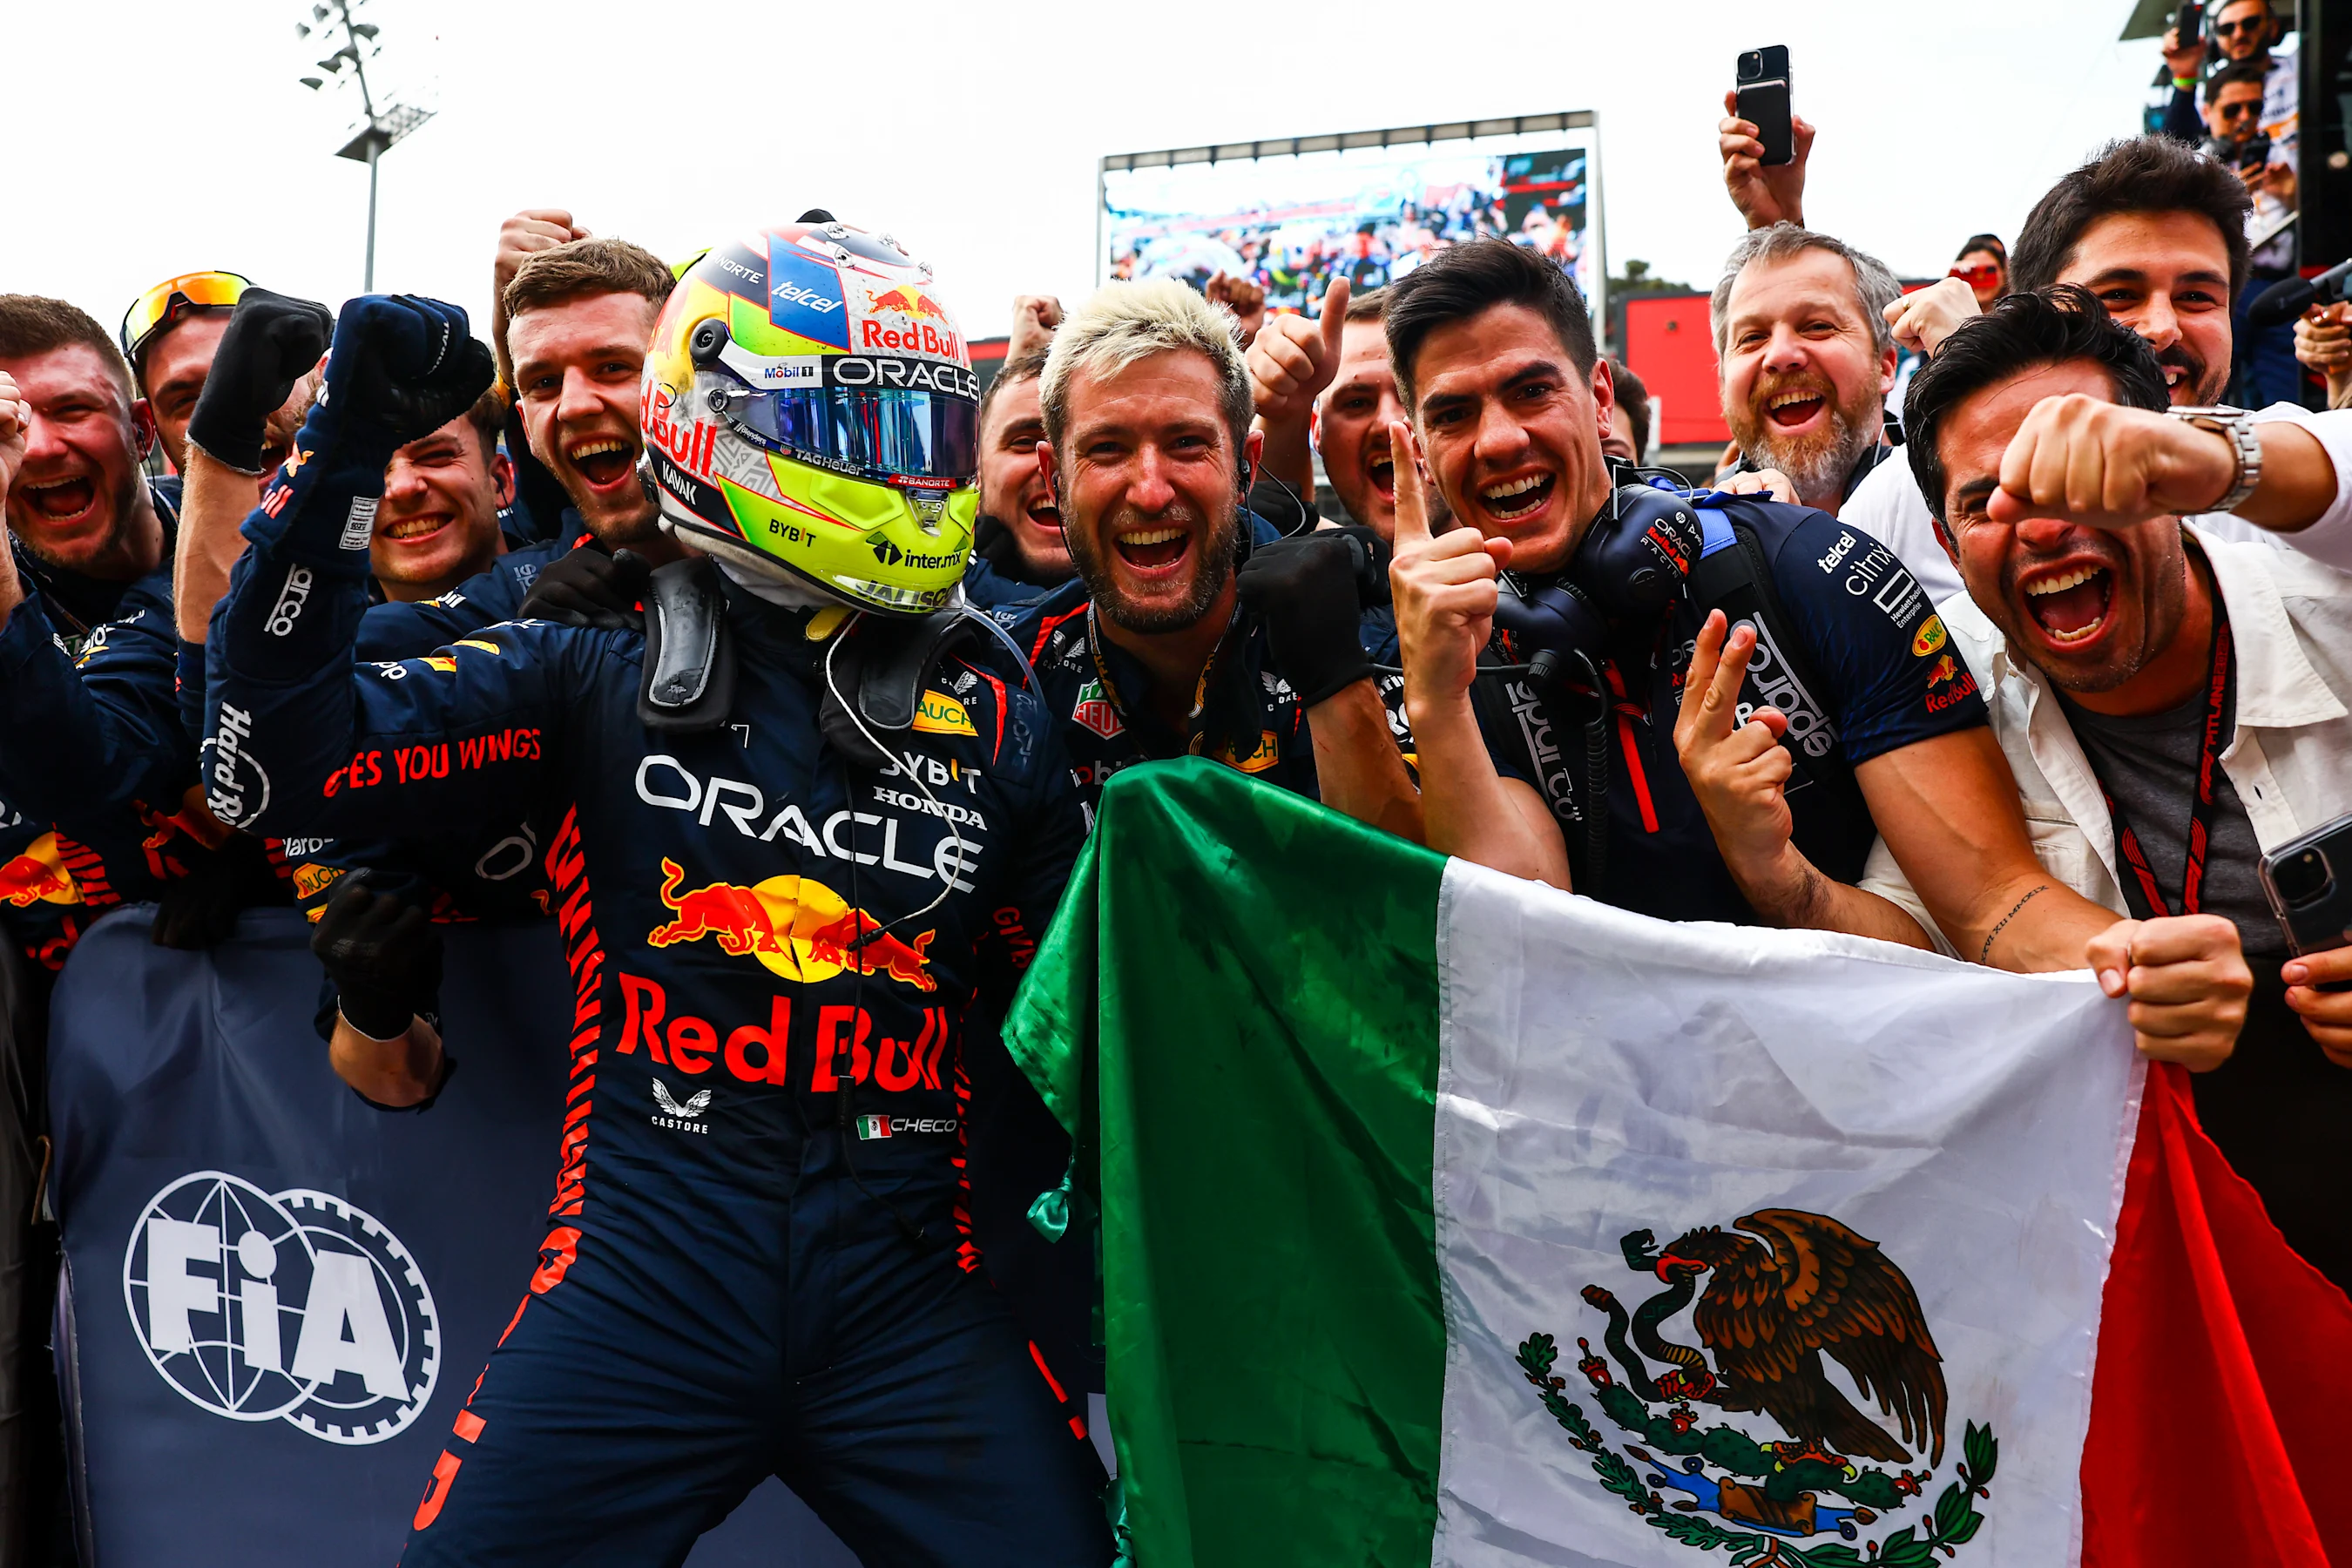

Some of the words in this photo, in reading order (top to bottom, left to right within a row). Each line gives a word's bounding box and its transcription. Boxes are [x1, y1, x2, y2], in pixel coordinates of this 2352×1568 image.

[713, 253, 764, 284] ANORTE
[771, 280, 843, 314] telcel
[862, 320, 919, 350] Red
[922, 325, 959, 361] Bull
[765, 367, 799, 379] Mobil
[833, 357, 981, 402] ORACLE
[662, 461, 698, 505] KAVAK
[907, 477, 950, 487] BANORTE
[769, 518, 816, 548] BYBIT
[1655, 517, 1692, 558] ORACL
[1817, 530, 1856, 574] telcel
[904, 549, 962, 569] inter.mx
[1640, 537, 1679, 578] RACIN
[1846, 542, 1895, 596] citrix
[271, 568, 313, 637] arco
[1889, 597, 1913, 622] Hewlett
[1896, 601, 1923, 629] Enterprise
[1923, 622, 1943, 645] RAUC
[917, 702, 975, 729] AUCH
[217, 701, 253, 793] Hard
[394, 743, 449, 784] YOU
[458, 728, 541, 770] WINGS
[635, 754, 985, 893] ORACLE
[873, 786, 988, 831] HONDA
[615, 971, 792, 1087] Red
[810, 1004, 948, 1094] Bull
[651, 1115, 709, 1135] CASTORE
[889, 1116, 956, 1134] CHECO
